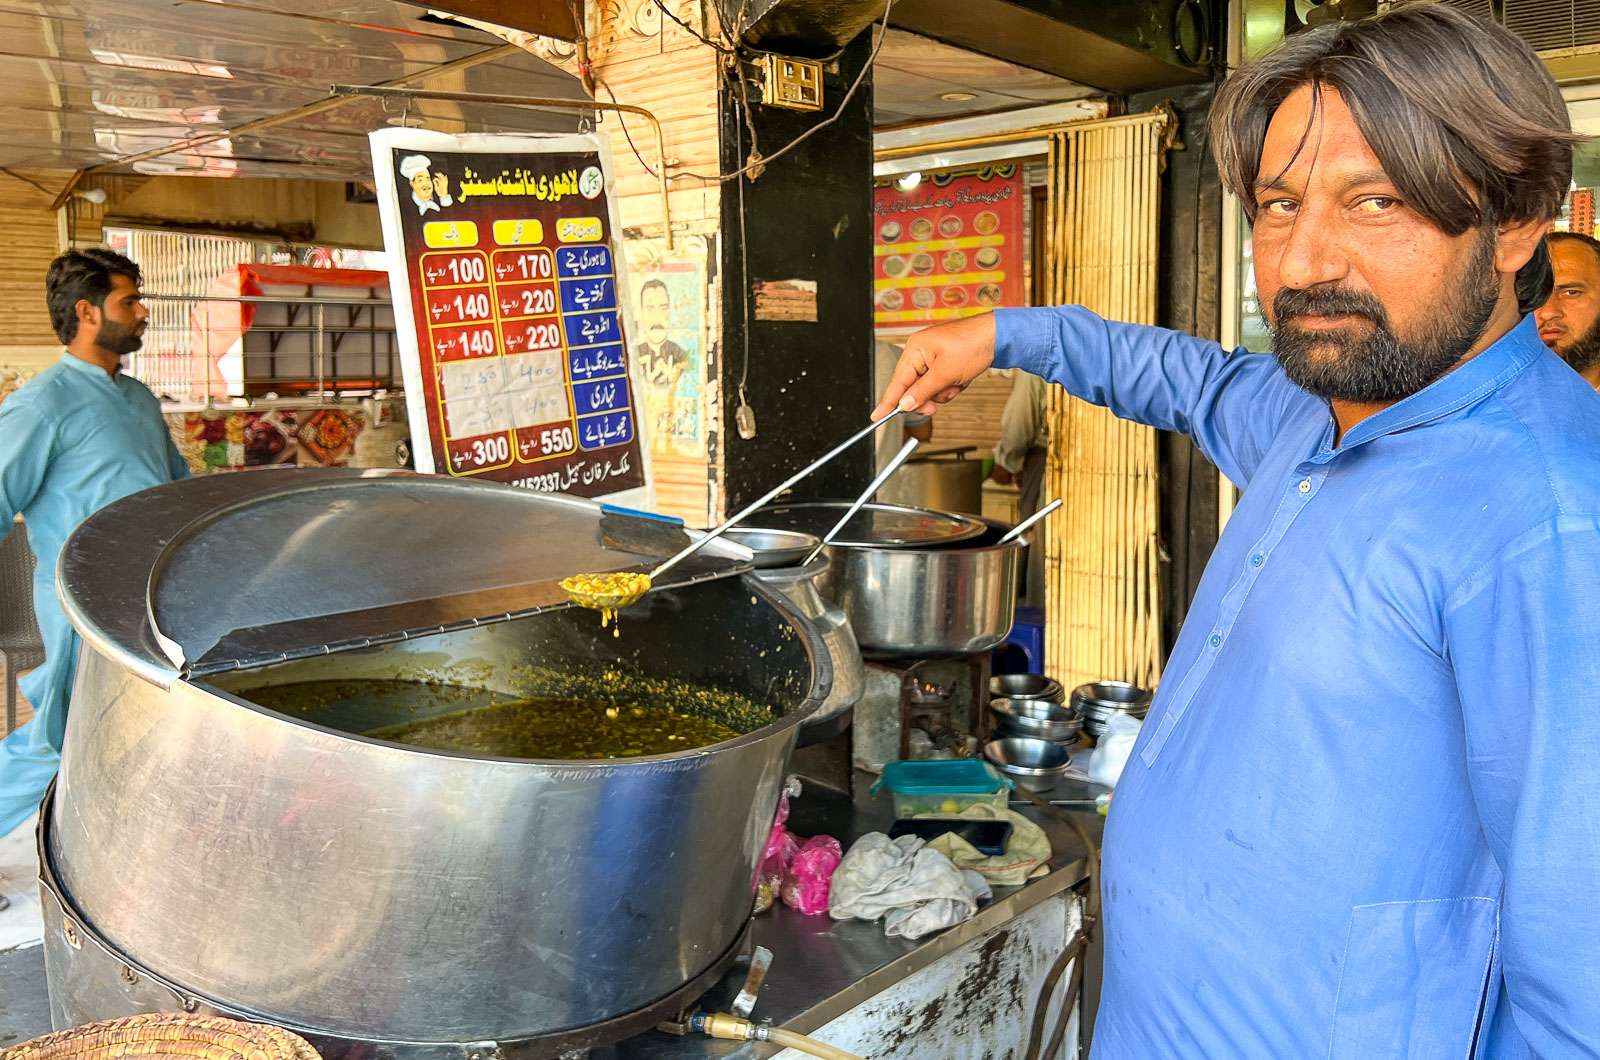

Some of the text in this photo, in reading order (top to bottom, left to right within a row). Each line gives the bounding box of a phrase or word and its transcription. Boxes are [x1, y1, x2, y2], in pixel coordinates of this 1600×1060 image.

[457, 166, 498, 203] سنٹر
[448, 257, 485, 283] 100
[518, 254, 551, 278] 170
[453, 293, 489, 320] 140
[522, 288, 555, 314] 220
[459, 330, 494, 356] 140
[526, 323, 560, 350] 220
[472, 436, 508, 465] 300
[540, 427, 573, 454] 550
